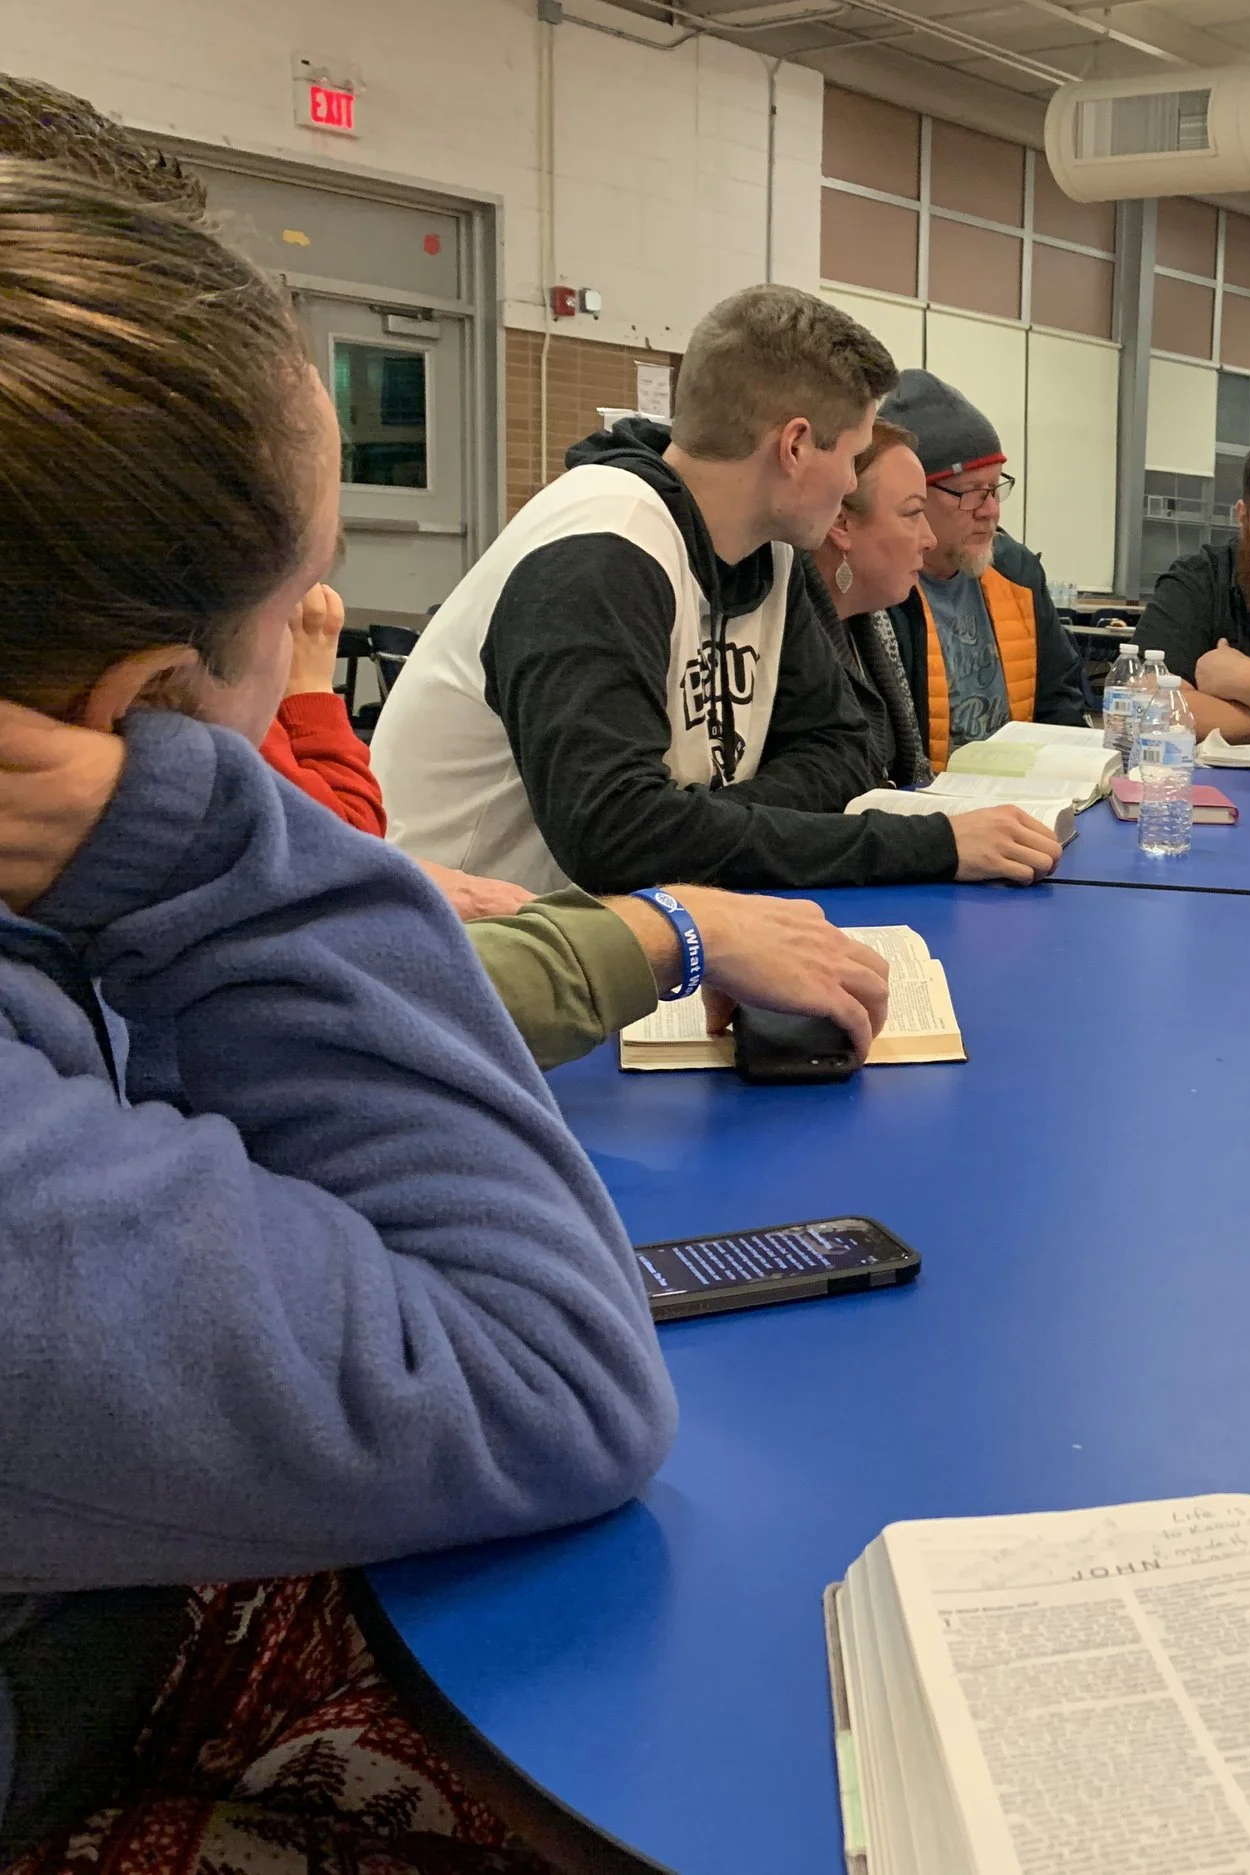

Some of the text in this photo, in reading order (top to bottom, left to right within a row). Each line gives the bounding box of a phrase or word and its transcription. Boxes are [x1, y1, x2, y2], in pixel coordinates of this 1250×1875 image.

[310, 86, 354, 129] EXIT
[683, 928, 701, 974] What
[1071, 1558, 1162, 1582] JOHN
